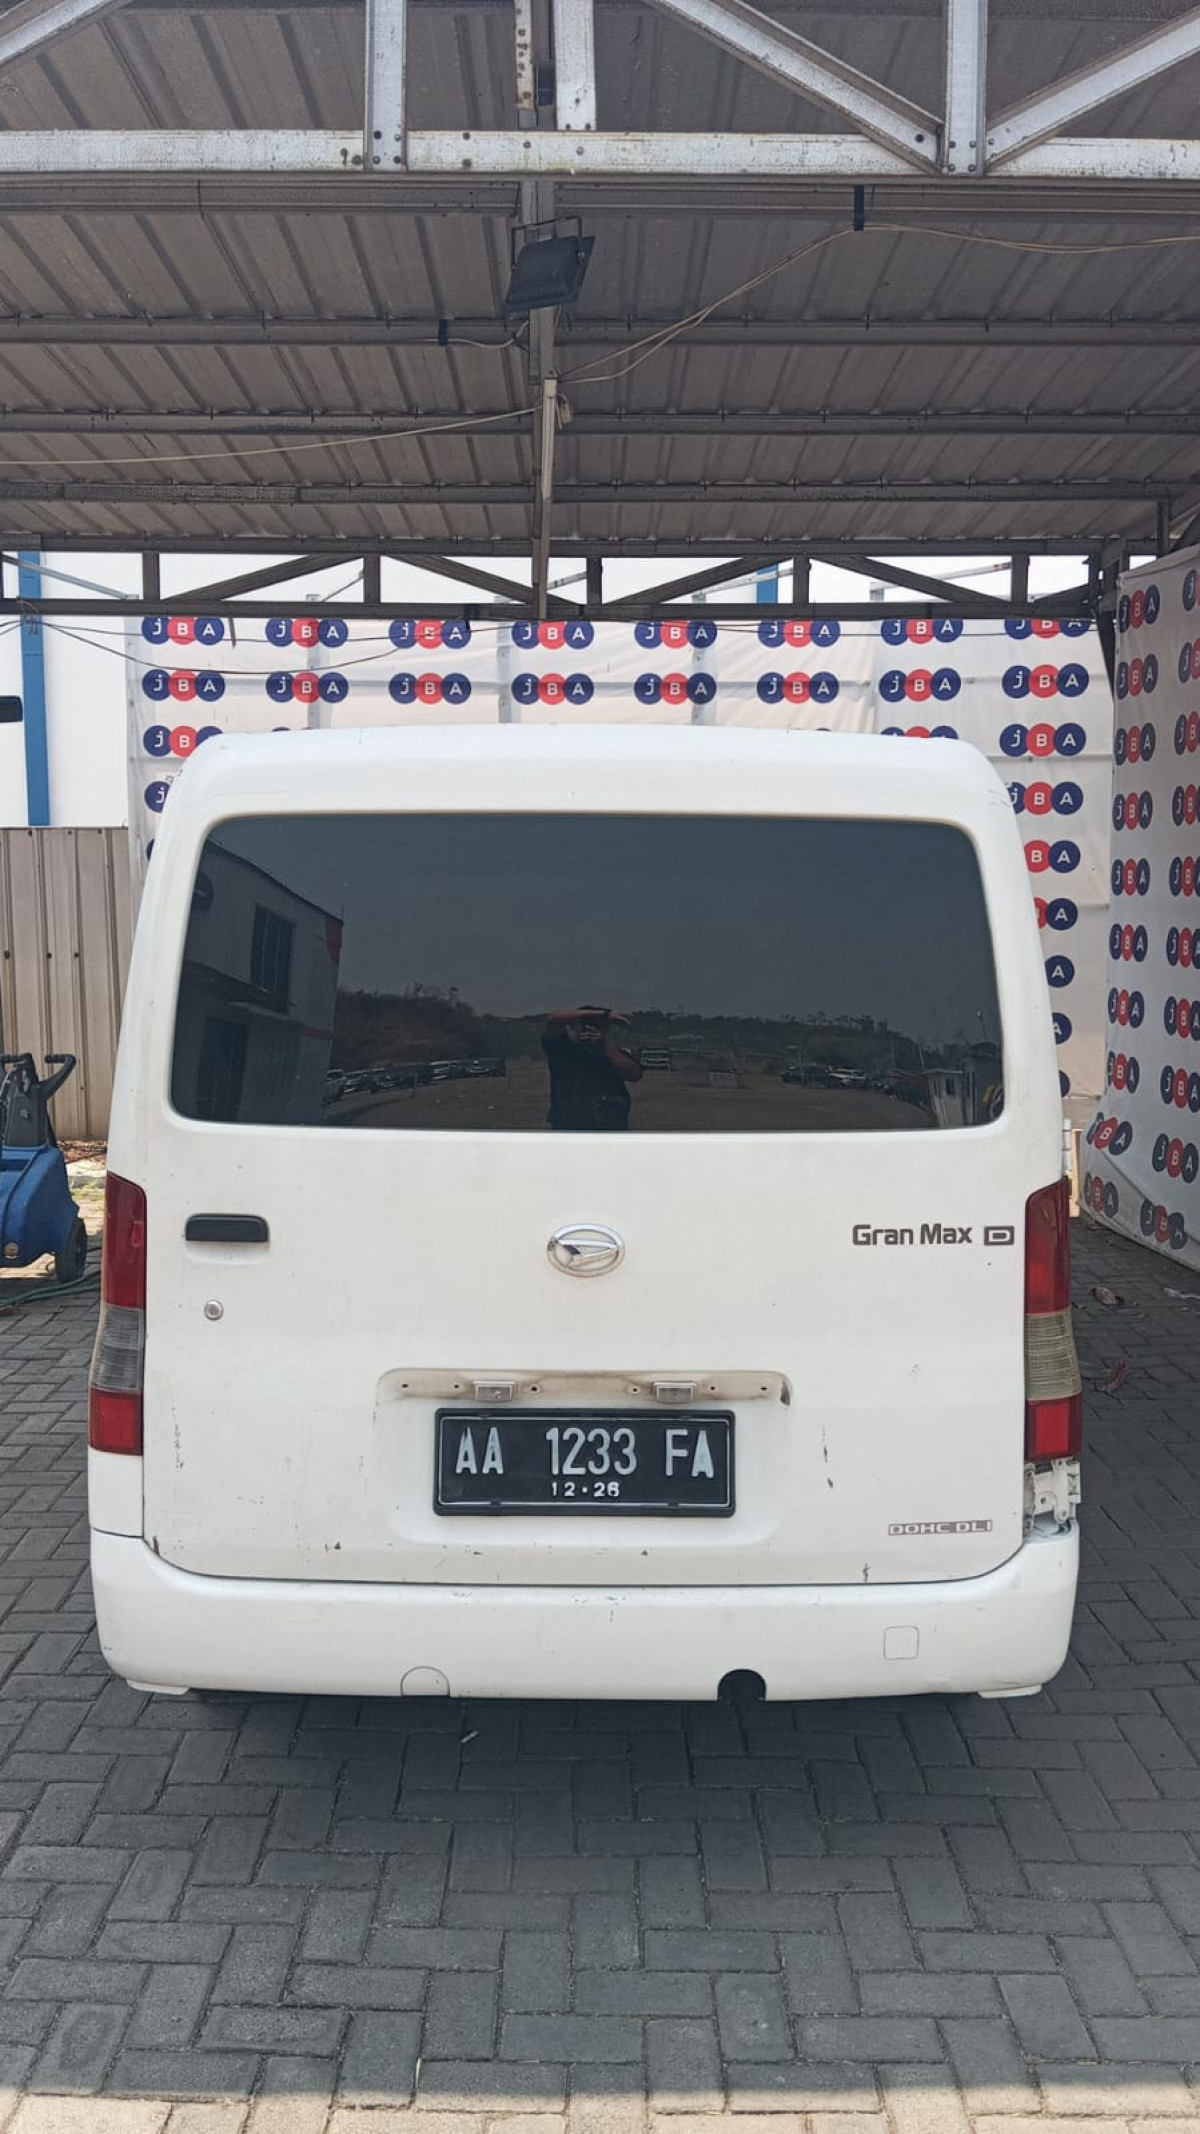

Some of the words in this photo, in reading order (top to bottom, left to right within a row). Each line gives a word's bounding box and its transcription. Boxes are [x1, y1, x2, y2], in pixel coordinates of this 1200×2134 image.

[852, 1224, 914, 1246] Gran
[919, 1223, 973, 1245] Max
[454, 1426, 504, 1475] AA
[545, 1426, 638, 1477] 1233
[665, 1428, 715, 1479] FA
[889, 1523, 951, 1535] DOHC
